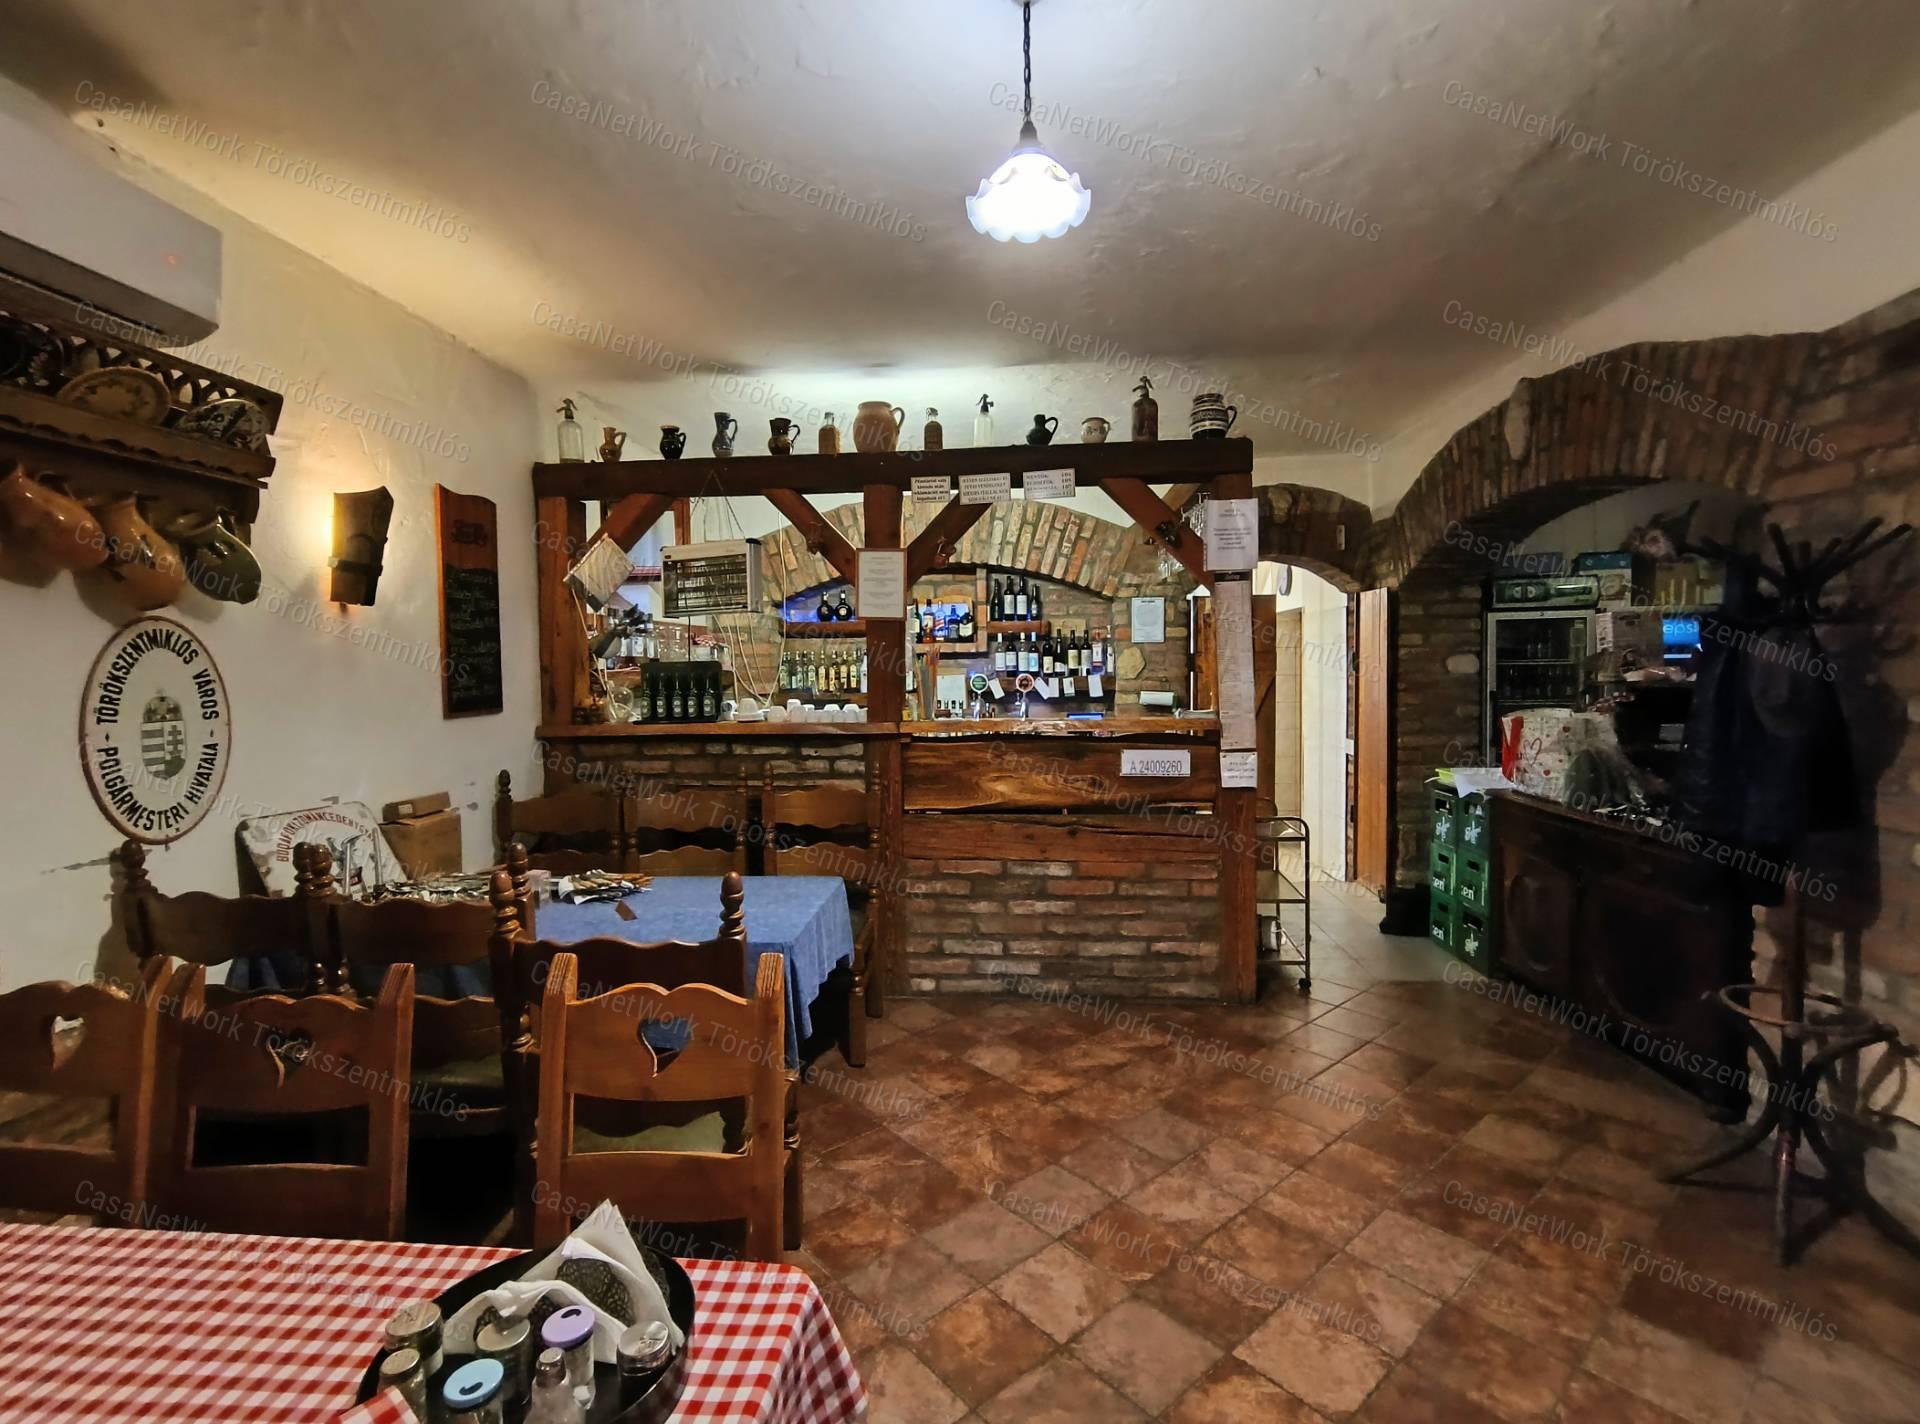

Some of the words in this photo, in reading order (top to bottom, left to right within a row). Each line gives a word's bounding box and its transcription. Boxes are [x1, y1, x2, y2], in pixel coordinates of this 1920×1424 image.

[1663, 621, 1697, 637] epsi
[93, 628, 199, 725] TÖRÖKSZENTMIKLÓS
[192, 668, 220, 720] VÁROS
[97, 746, 190, 831] POLGÁRMESTERI
[184, 742, 219, 805] HIVATALA
[1130, 760, 1137, 772] A
[1139, 760, 1182, 773] 24009260
